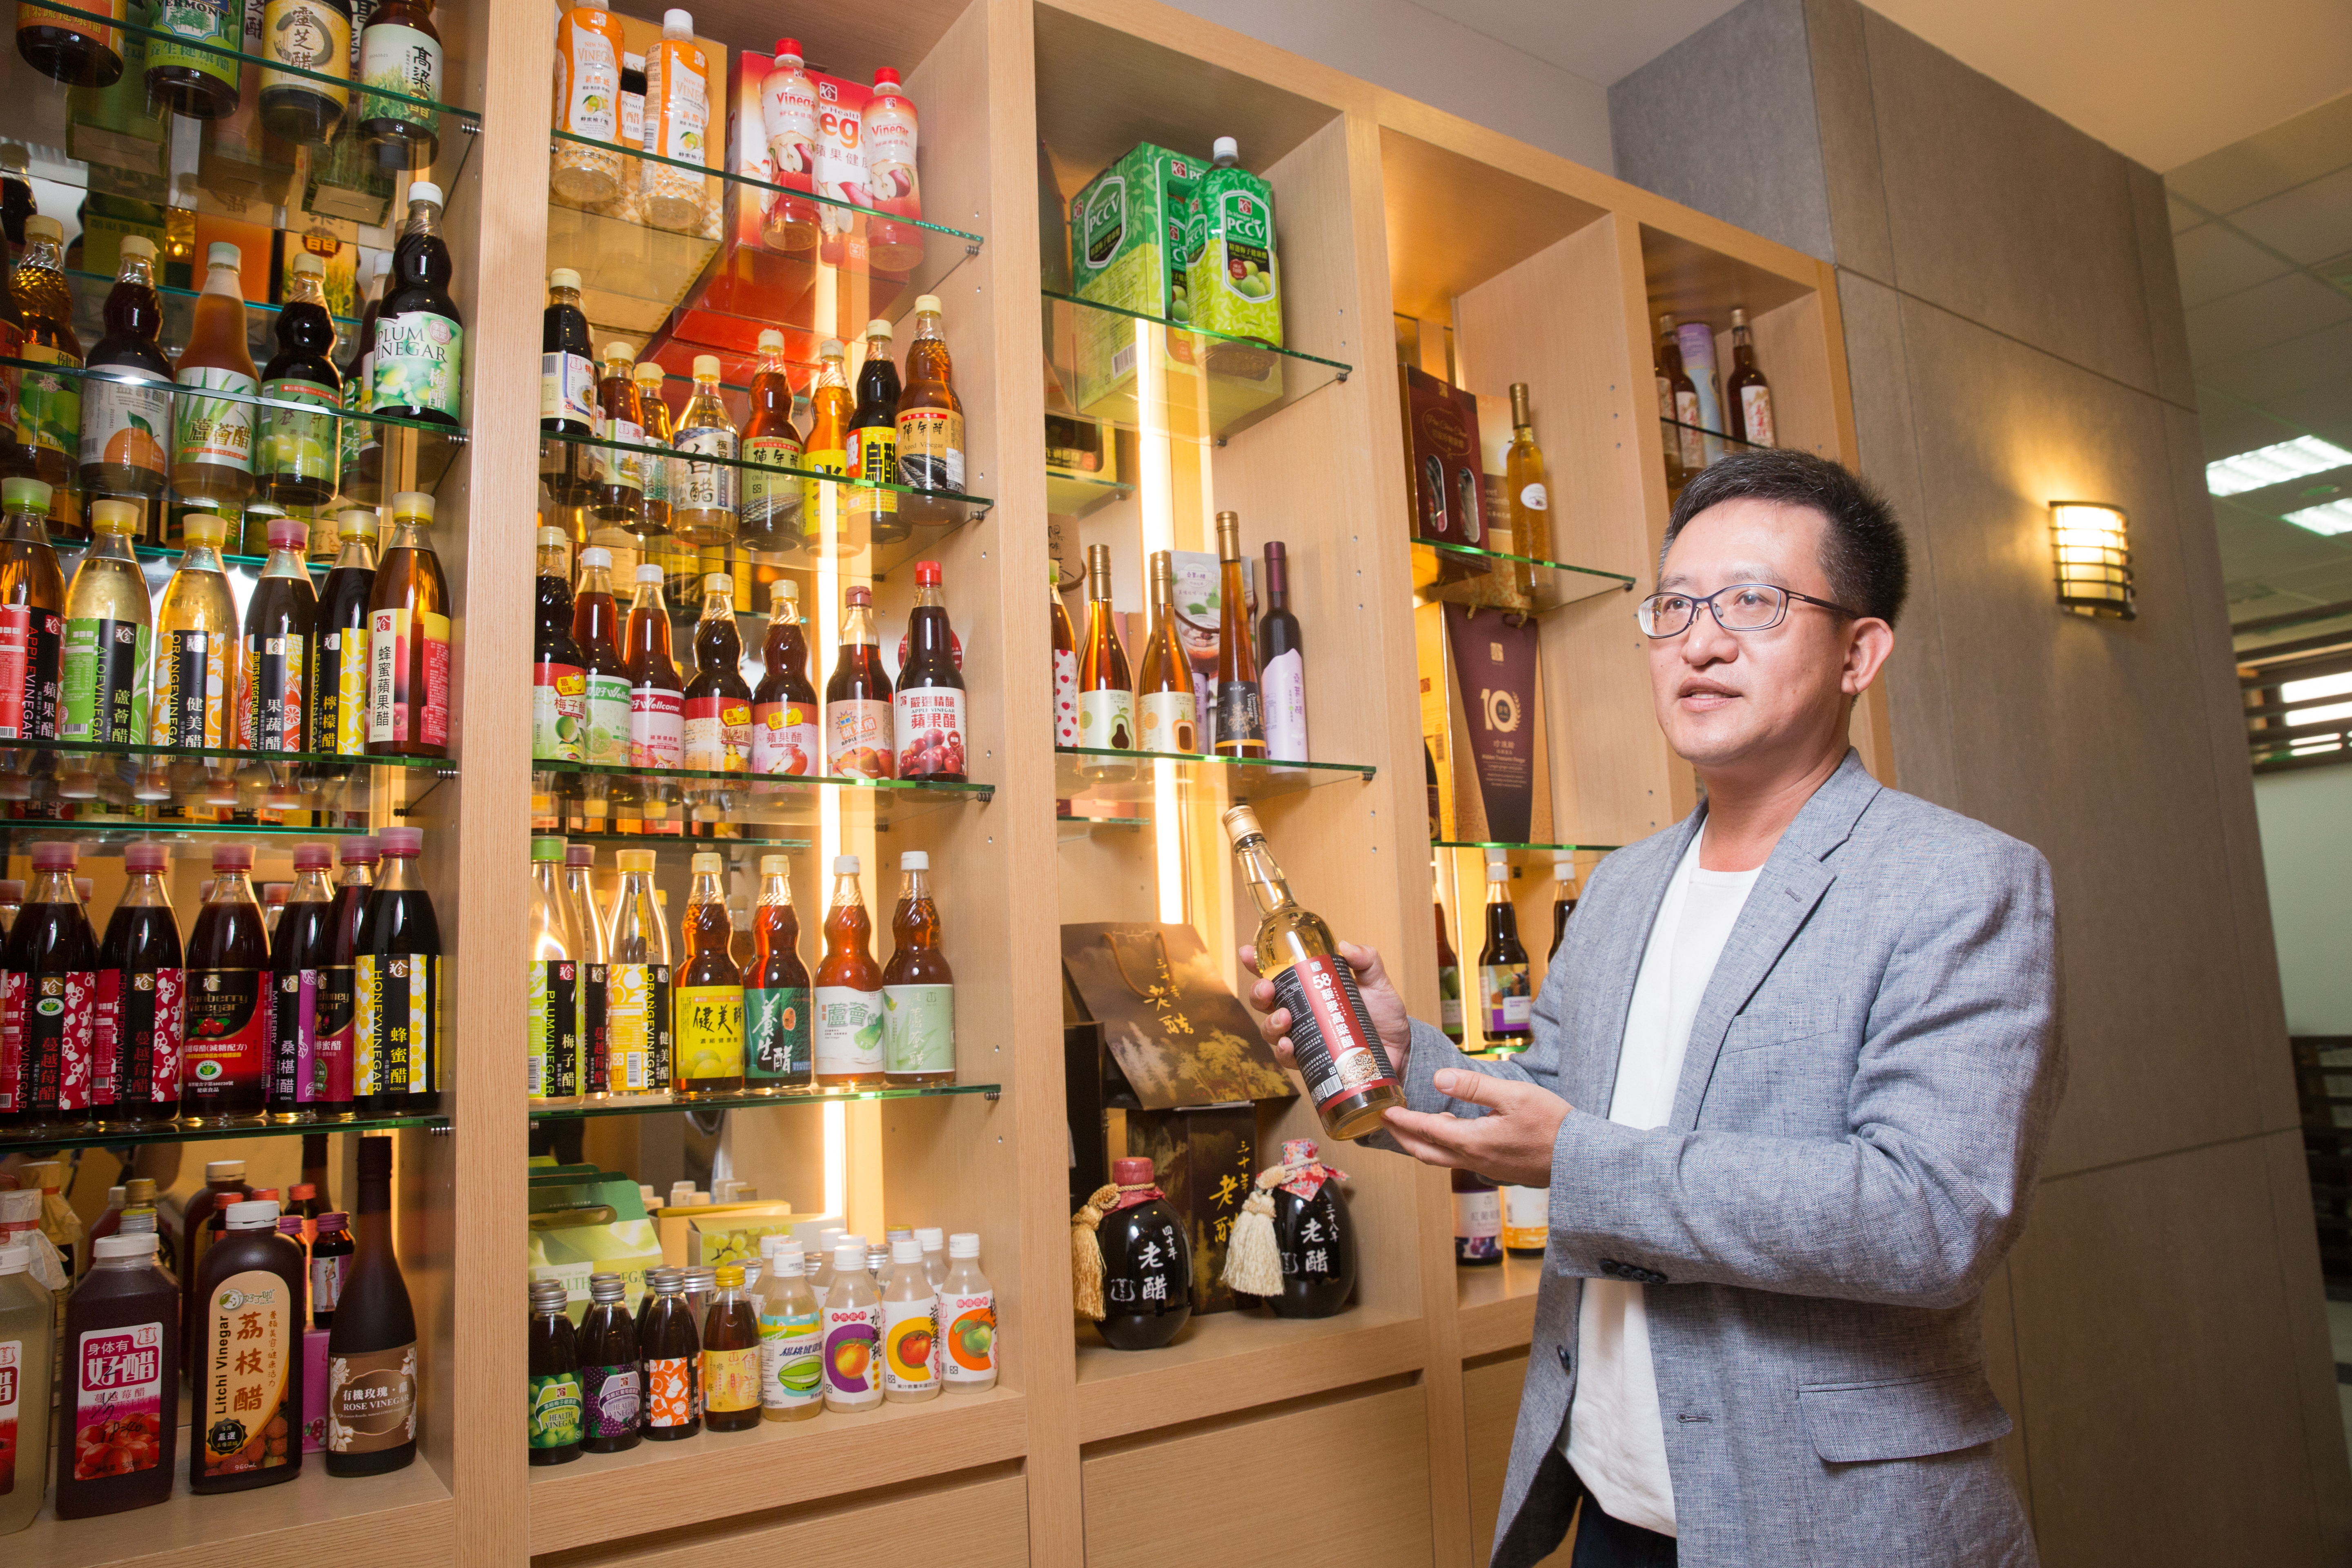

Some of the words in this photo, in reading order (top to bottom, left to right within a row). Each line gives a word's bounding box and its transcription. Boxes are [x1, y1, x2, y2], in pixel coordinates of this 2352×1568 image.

[1227, 217, 1265, 238] PCCV
[378, 326, 425, 342] PLUM
[374, 342, 448, 363] VINEGAR
[903, 443, 917, 451] Aged
[376, 646, 391, 727] 蜂蜜蘋果醋
[41, 681, 56, 737] 蘋果醋
[641, 697, 680, 712] Wellcome
[910, 695, 955, 708] 嚴選精釀
[112, 689, 130, 744] 蘆薈醋
[266, 699, 282, 750] 果蔬醋
[321, 695, 337, 748] 檸檬醋
[911, 713, 956, 729] 蘋果醋
[766, 732, 802, 744] 蘋果醋
[390, 1027, 407, 1084] 蜂蜜醋
[561, 1034, 575, 1087] 梅子醋
[1301, 1218, 1329, 1273] 老醋
[1138, 1241, 1167, 1300] 老醋
[87, 1339, 129, 1356] 身体有
[216, 1316, 232, 1370] Vinegar
[87, 1350, 156, 1388] 好醋
[234, 1311, 264, 1412] 荔枝醋
[215, 1374, 227, 1414] Litchi
[343, 1402, 368, 1411] ROSE
[370, 1394, 410, 1409] VINEGAR
[545, 1418, 576, 1429] VINEGAR
[549, 1411, 573, 1421] HEALTH
[218, 1432, 236, 1441] 嚴選
[235, 1462, 256, 1470] 960mL
